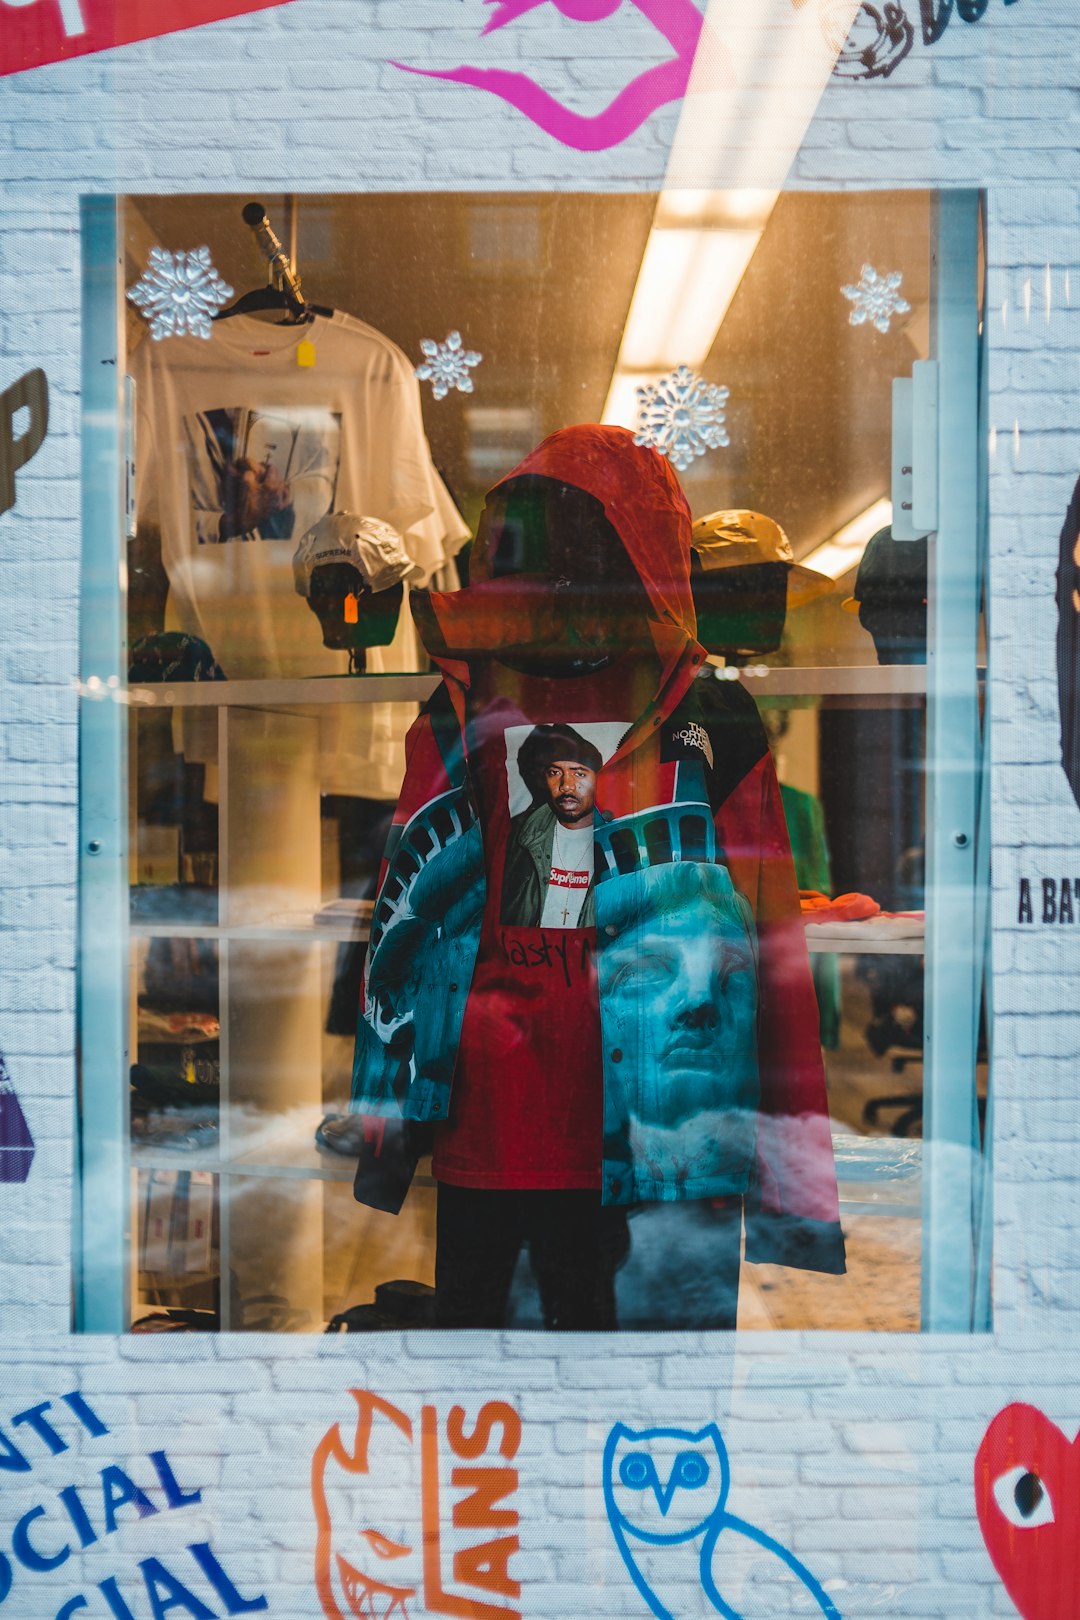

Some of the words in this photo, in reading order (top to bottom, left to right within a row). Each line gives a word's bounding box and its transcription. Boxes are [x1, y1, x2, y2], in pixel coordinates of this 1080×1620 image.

[684, 738, 706, 752] FAC
[550, 869, 588, 884] Supreme
[1018, 878, 1032, 924] A
[0, 1450, 202, 1603] CIAL
